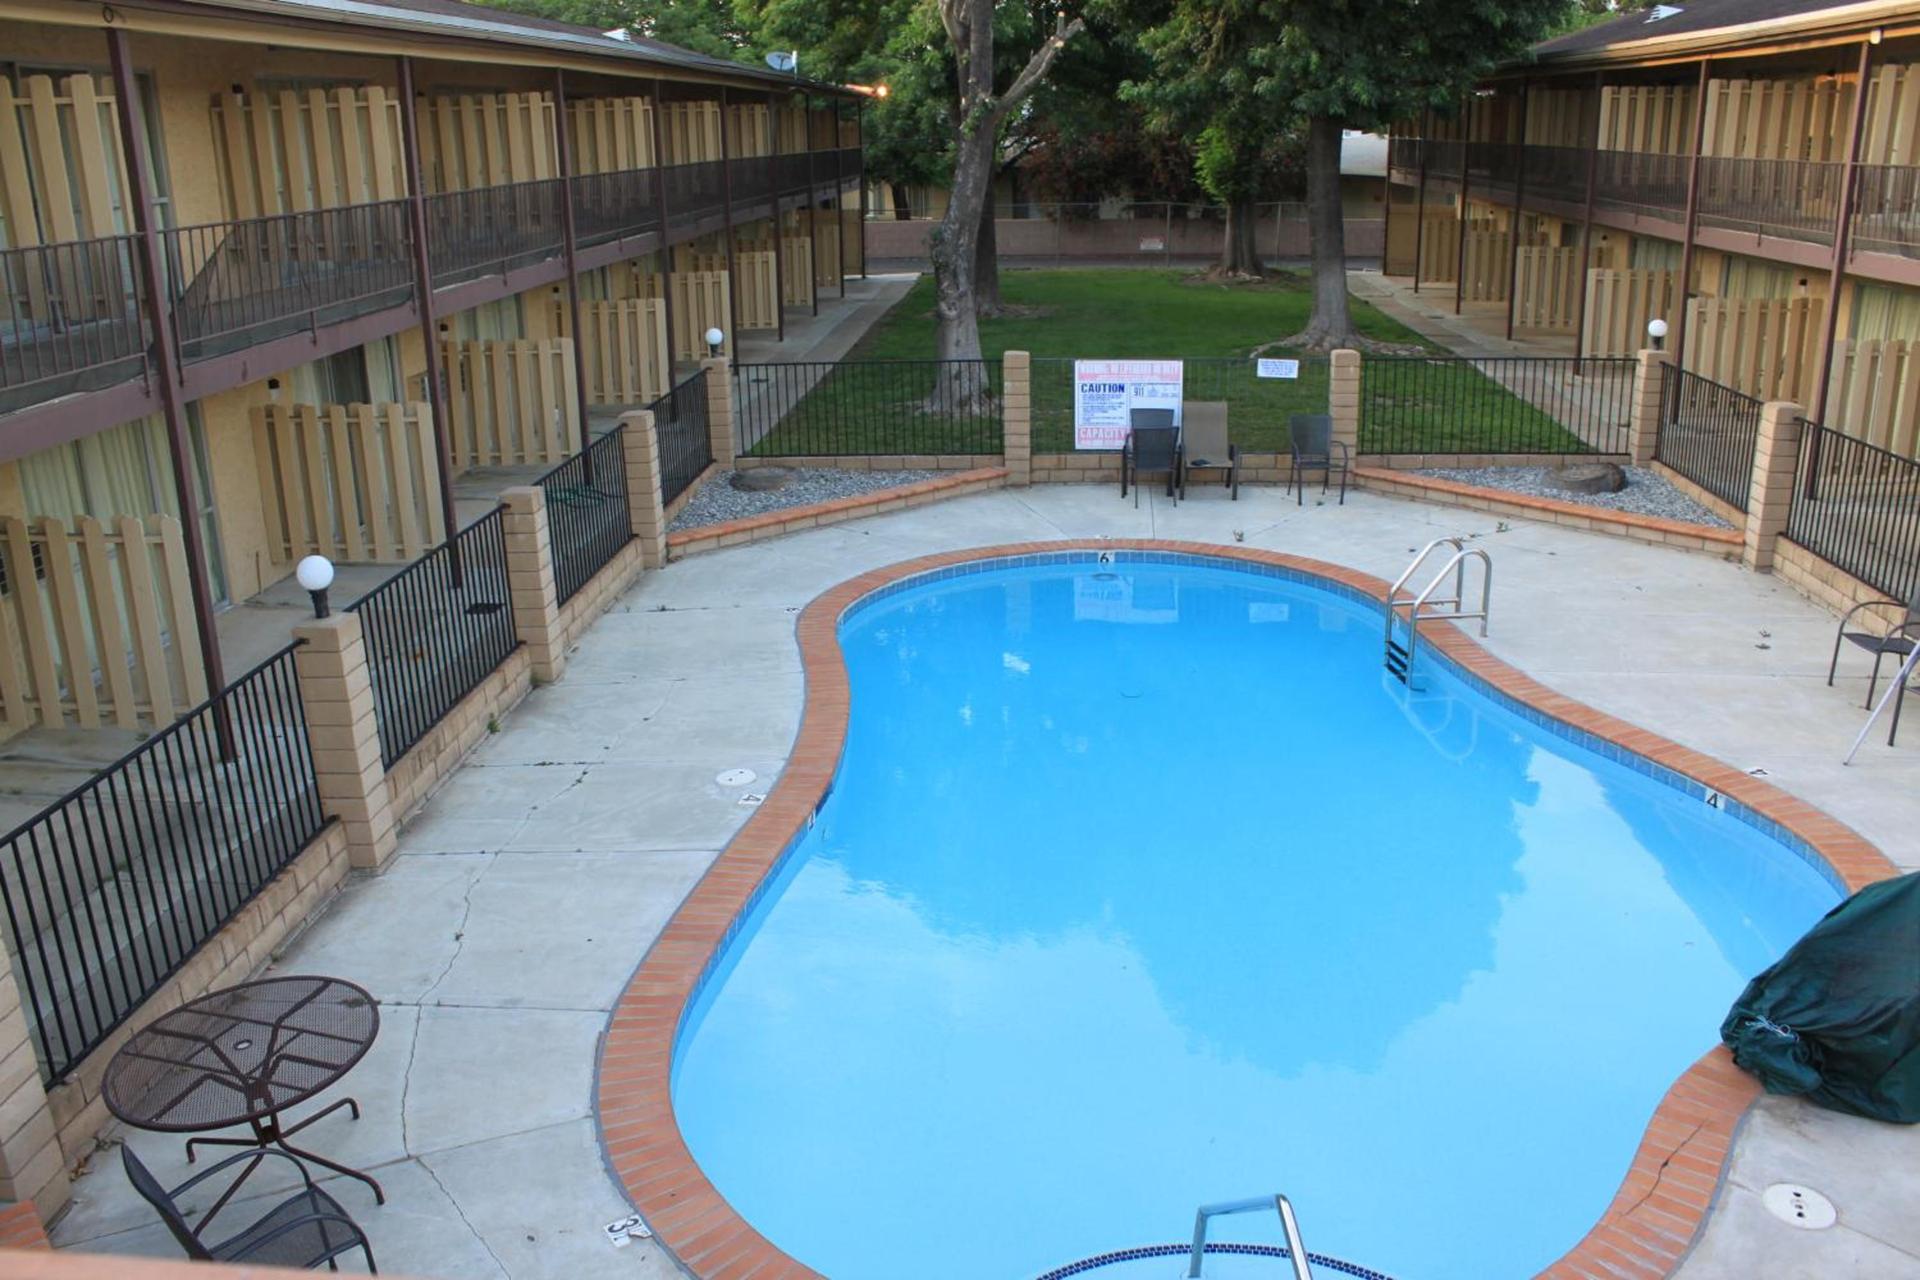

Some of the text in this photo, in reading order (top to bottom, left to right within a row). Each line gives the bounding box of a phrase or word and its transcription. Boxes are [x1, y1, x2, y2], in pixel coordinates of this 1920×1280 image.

[1081, 383, 1125, 393] CAUTION
[1134, 387, 1144, 397] 911
[1080, 428, 1126, 439] CAPACITY
[1100, 552, 1109, 563] 6
[1706, 792, 1718, 808] 4
